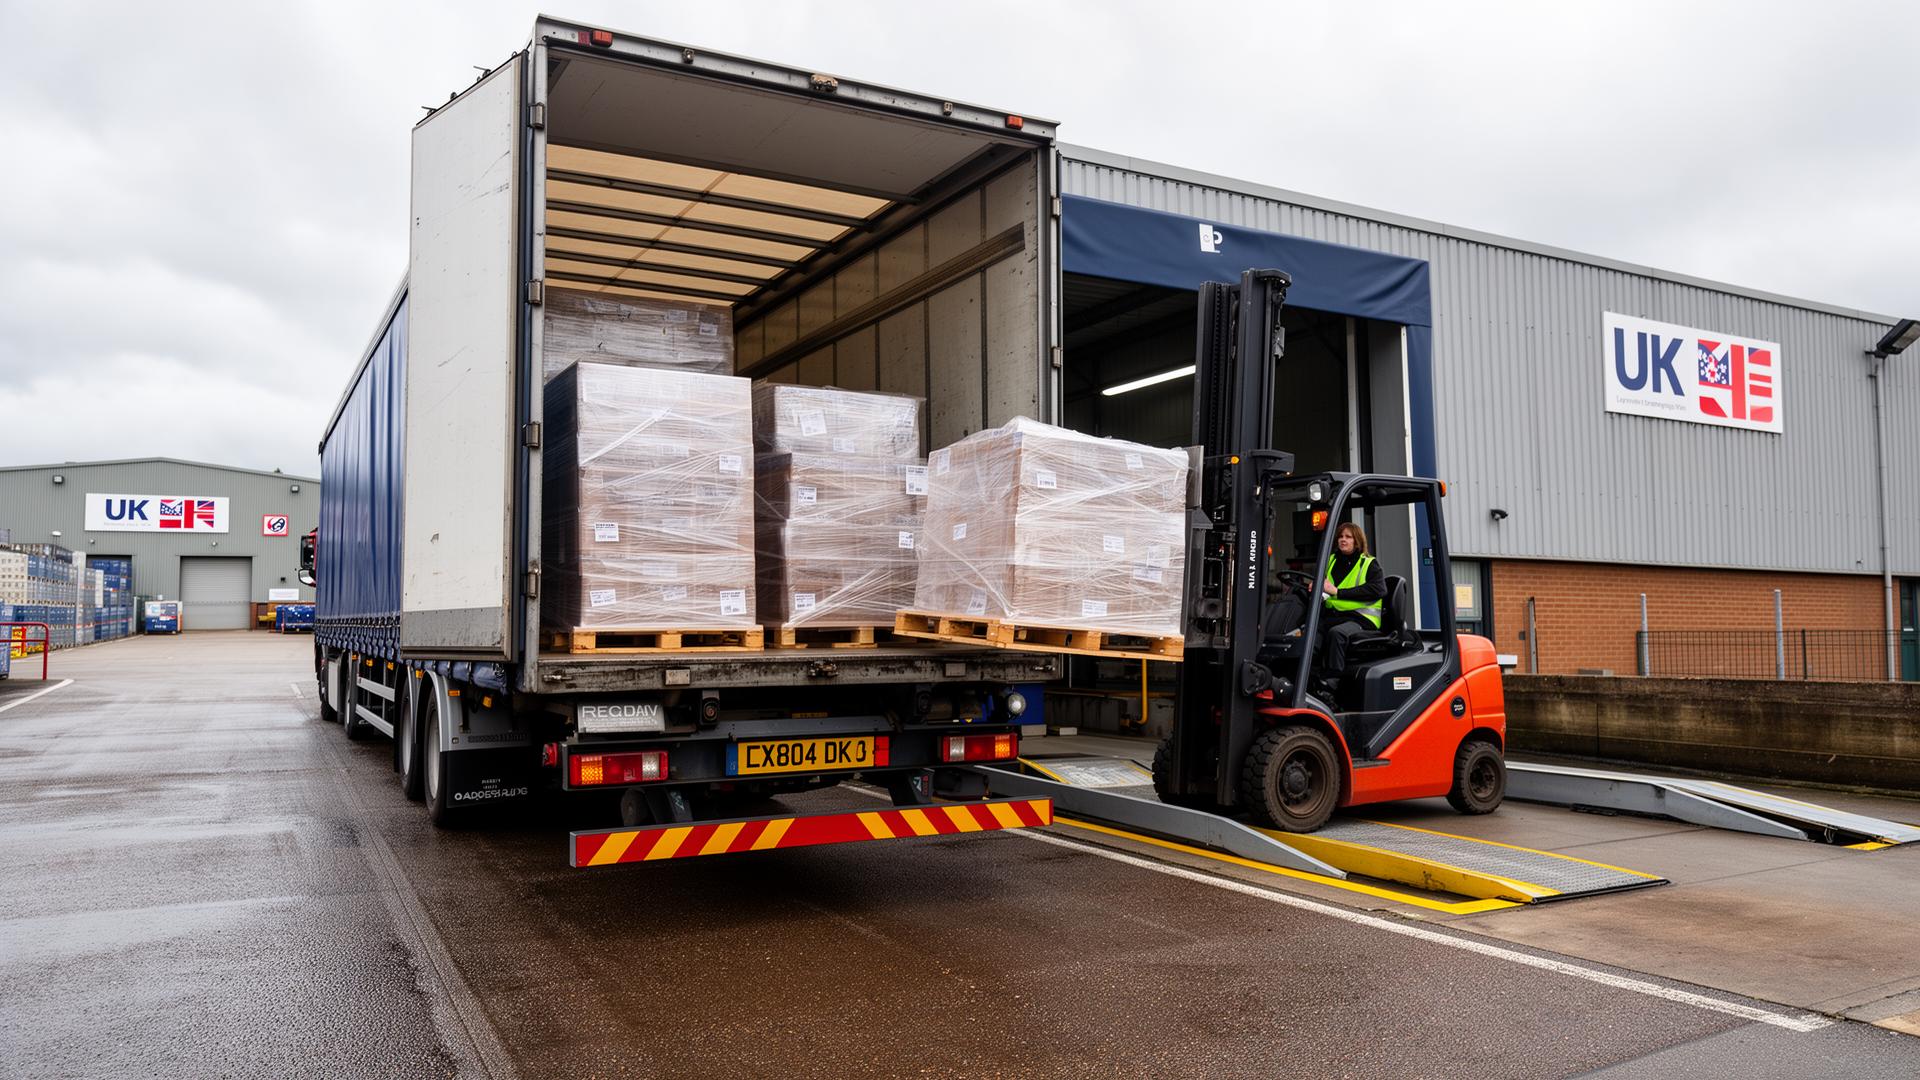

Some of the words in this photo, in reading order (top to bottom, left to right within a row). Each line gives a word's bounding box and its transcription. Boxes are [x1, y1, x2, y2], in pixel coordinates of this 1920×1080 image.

[1614, 327, 1685, 397] UK
[105, 498, 149, 521] UK
[747, 743, 817, 768] CX804
